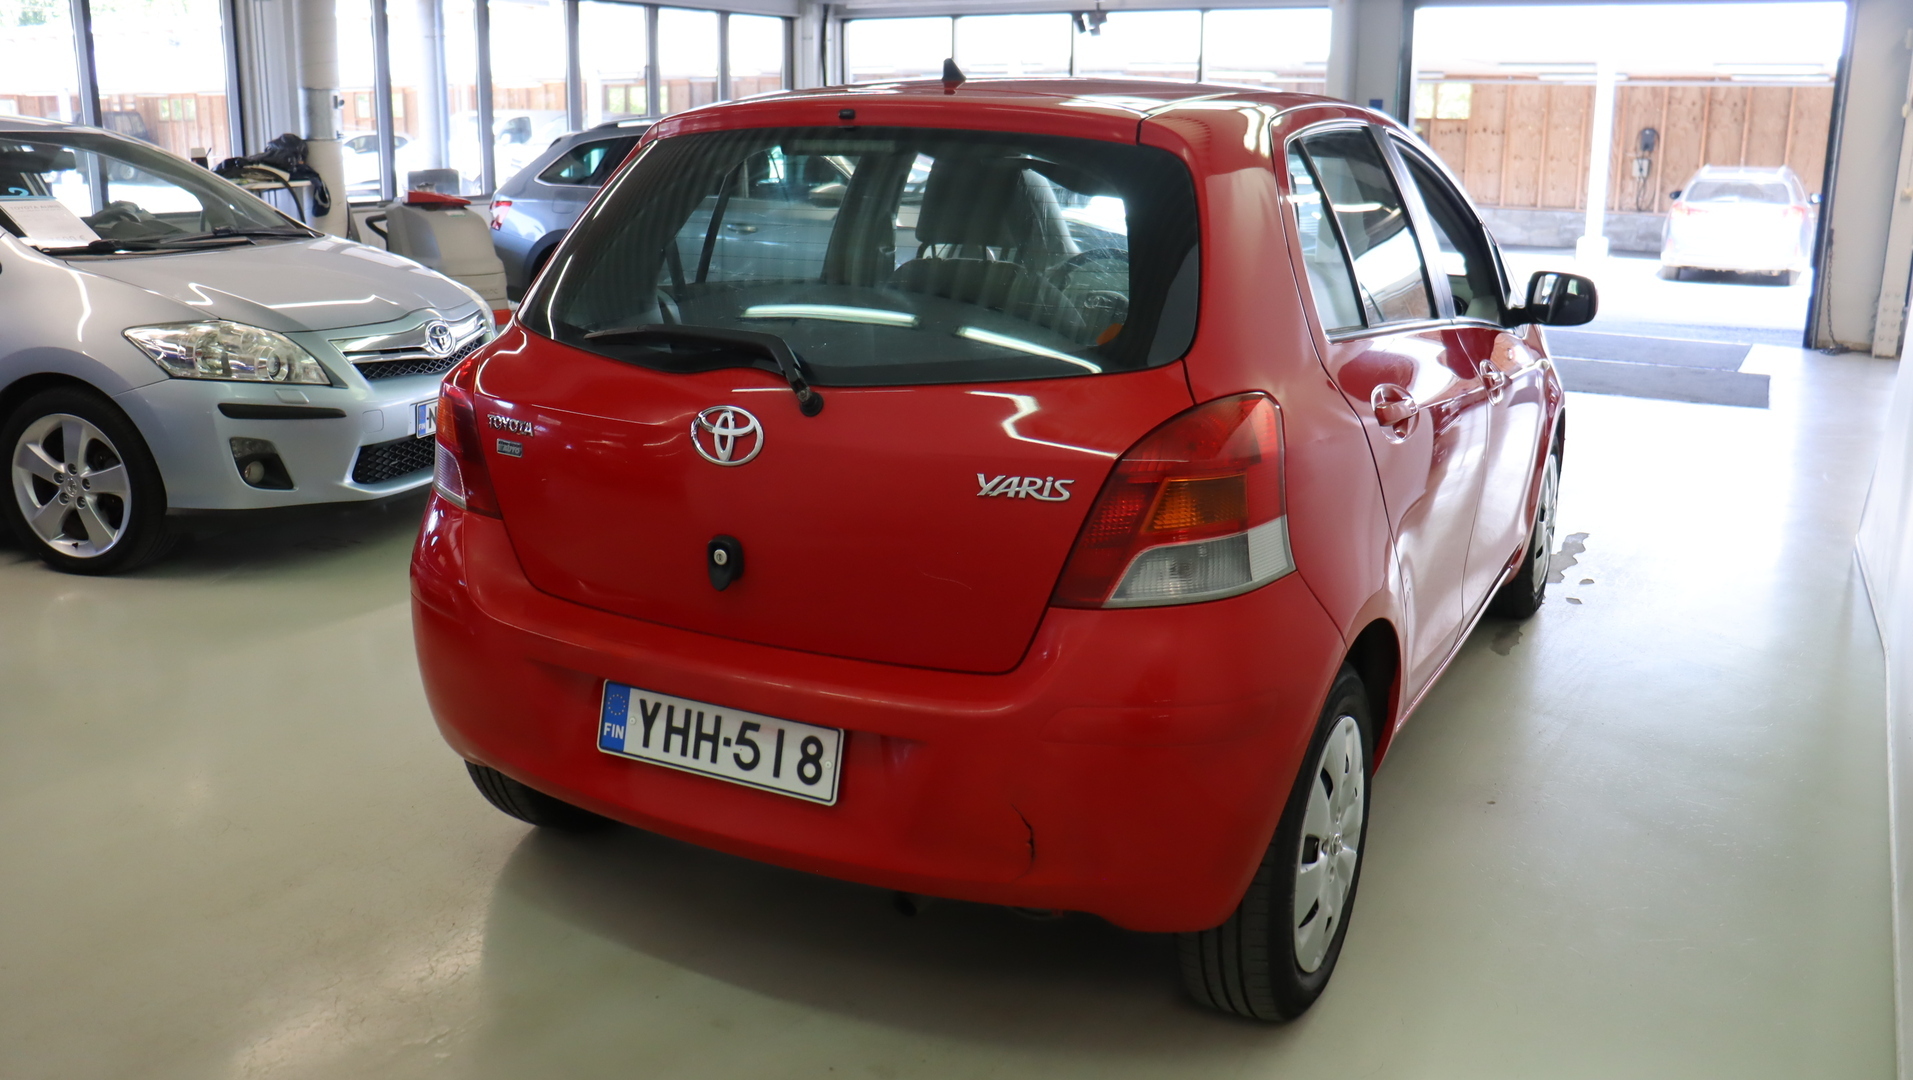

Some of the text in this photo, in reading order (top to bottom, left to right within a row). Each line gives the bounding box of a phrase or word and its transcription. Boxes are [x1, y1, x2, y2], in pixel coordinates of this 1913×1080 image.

[487, 413, 534, 437] TOYOTA
[603, 721, 625, 740] FIN
[639, 698, 824, 786] YHH-518
